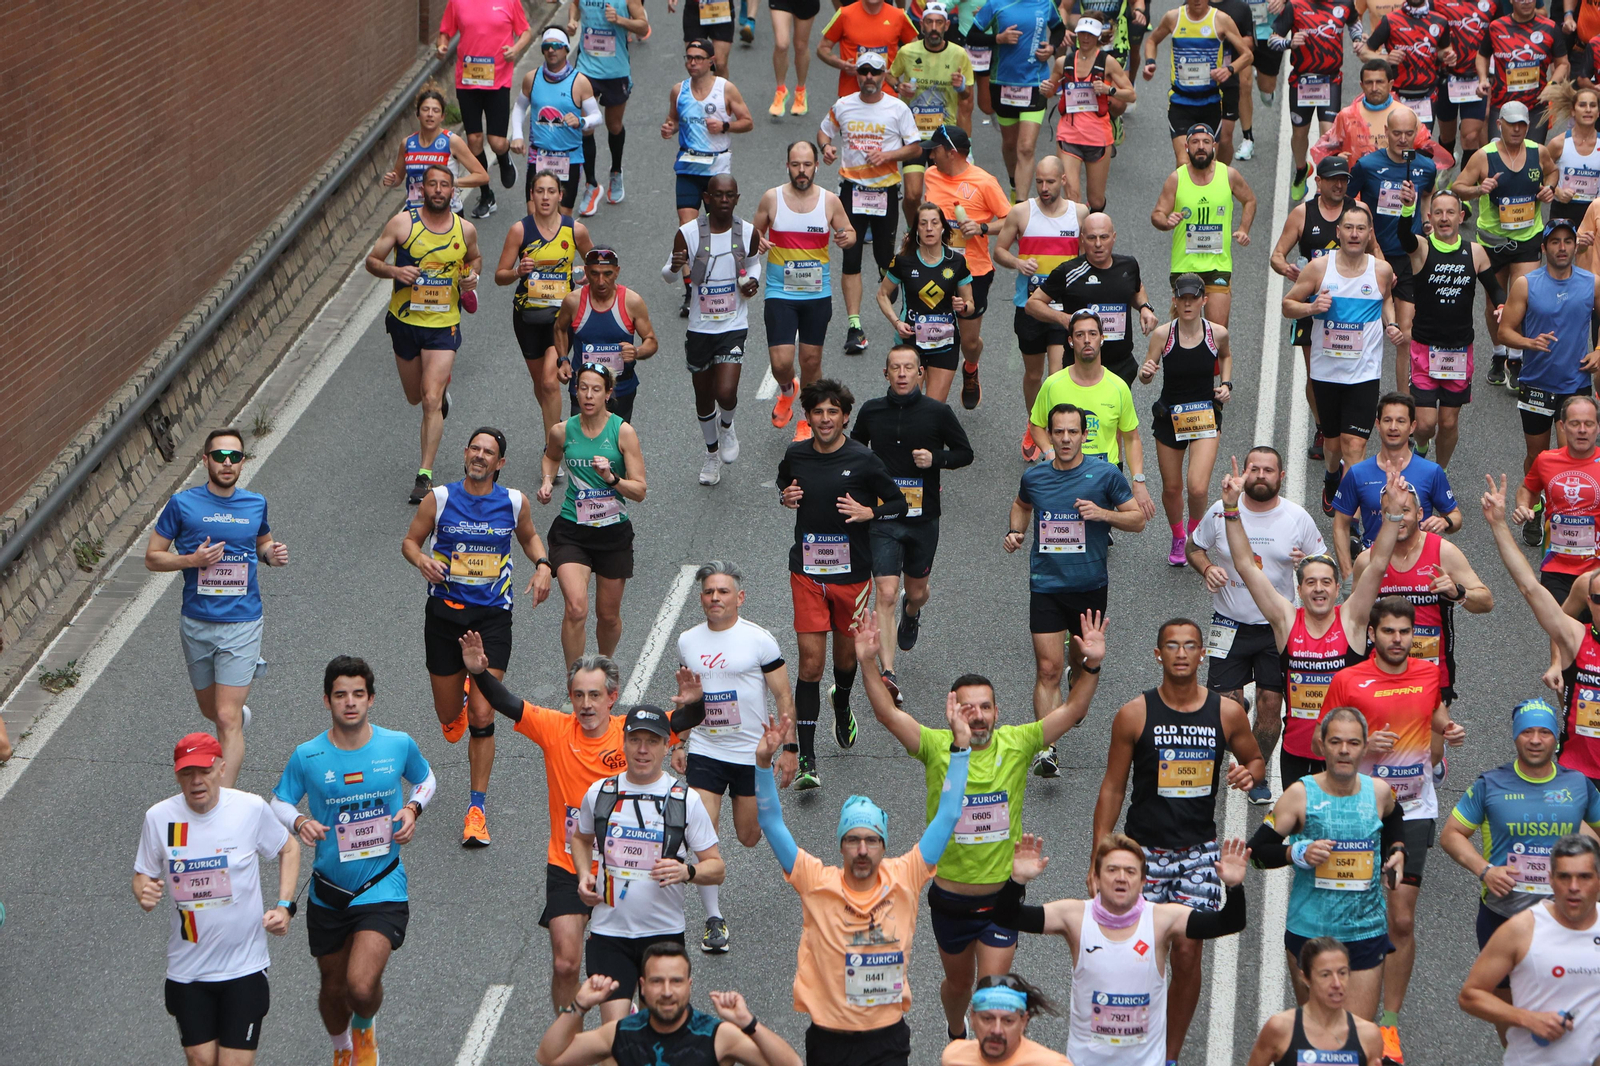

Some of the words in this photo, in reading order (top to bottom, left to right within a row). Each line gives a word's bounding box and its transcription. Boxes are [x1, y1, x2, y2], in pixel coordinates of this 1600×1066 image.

[920, 106, 940, 114] ZURICH
[847, 121, 885, 134] GRAN
[415, 154, 444, 162] PUEBLA
[1576, 169, 1597, 177] ZURICH
[1512, 196, 1532, 204] ZURICH
[1434, 263, 1465, 273] CORRER
[709, 285, 732, 295] ZURICH
[1101, 304, 1124, 312] ZURICH
[1336, 322, 1360, 330] ZURICH
[596, 344, 620, 352] ZURICH
[1184, 402, 1208, 411] ZURICH
[1186, 415, 1201, 423] 5891
[587, 489, 611, 497] ZURICH
[459, 521, 489, 529] CLUB
[1563, 517, 1590, 525] ZURICH
[1053, 526, 1070, 534] 7058
[1563, 529, 1579, 537] 6457
[1044, 536, 1080, 544] CHICOMOLINA
[817, 548, 834, 556] 8089
[221, 554, 244, 562] URICH
[467, 558, 484, 566] 4441
[215, 568, 233, 576] 7372
[201, 578, 222, 586] VÍCTOR
[1380, 585, 1413, 593] atletismo
[1413, 627, 1435, 635] URICH
[1292, 650, 1323, 659] atletismo
[1324, 649, 1339, 658] club
[1289, 658, 1346, 671] MANCHATHON
[1305, 690, 1324, 698] 6066
[1373, 685, 1424, 698] ESPAÑA
[704, 693, 732, 701] ZURICH
[706, 708, 723, 716] 7879
[1153, 725, 1178, 735] OLD
[1181, 725, 1216, 737] TOWN
[1154, 735, 1217, 747] RUNNING
[1178, 751, 1209, 759] ZURICH
[1177, 767, 1197, 775] 5553
[1392, 766, 1420, 776] ZURICH
[971, 794, 1002, 805] ZURICH
[353, 807, 384, 820] ZURICH
[971, 811, 992, 820] 6605
[355, 825, 374, 837] 6937
[973, 825, 991, 833] JUAN
[1505, 822, 1574, 837] TUSSAM
[625, 829, 657, 840] ZURICH
[350, 837, 385, 850] ALFREDITO
[1337, 842, 1369, 850] ZURICH
[623, 846, 643, 856] 7620
[188, 859, 221, 870] ZURICH
[624, 860, 639, 868] PIET
[1335, 858, 1356, 867] 5547
[1526, 861, 1547, 871] 7633
[189, 877, 211, 887] 7517
[1524, 875, 1547, 883] HARRY
[192, 890, 213, 899] MARC
[866, 954, 899, 965] ZURICH
[865, 973, 885, 982] 8441
[1112, 996, 1145, 1005] ZURICH
[1110, 1013, 1131, 1022] 7921
[1096, 1025, 1117, 1034] CHICO
[1123, 1026, 1144, 1034] ELENA
[1320, 1053, 1354, 1063] ZURICH
